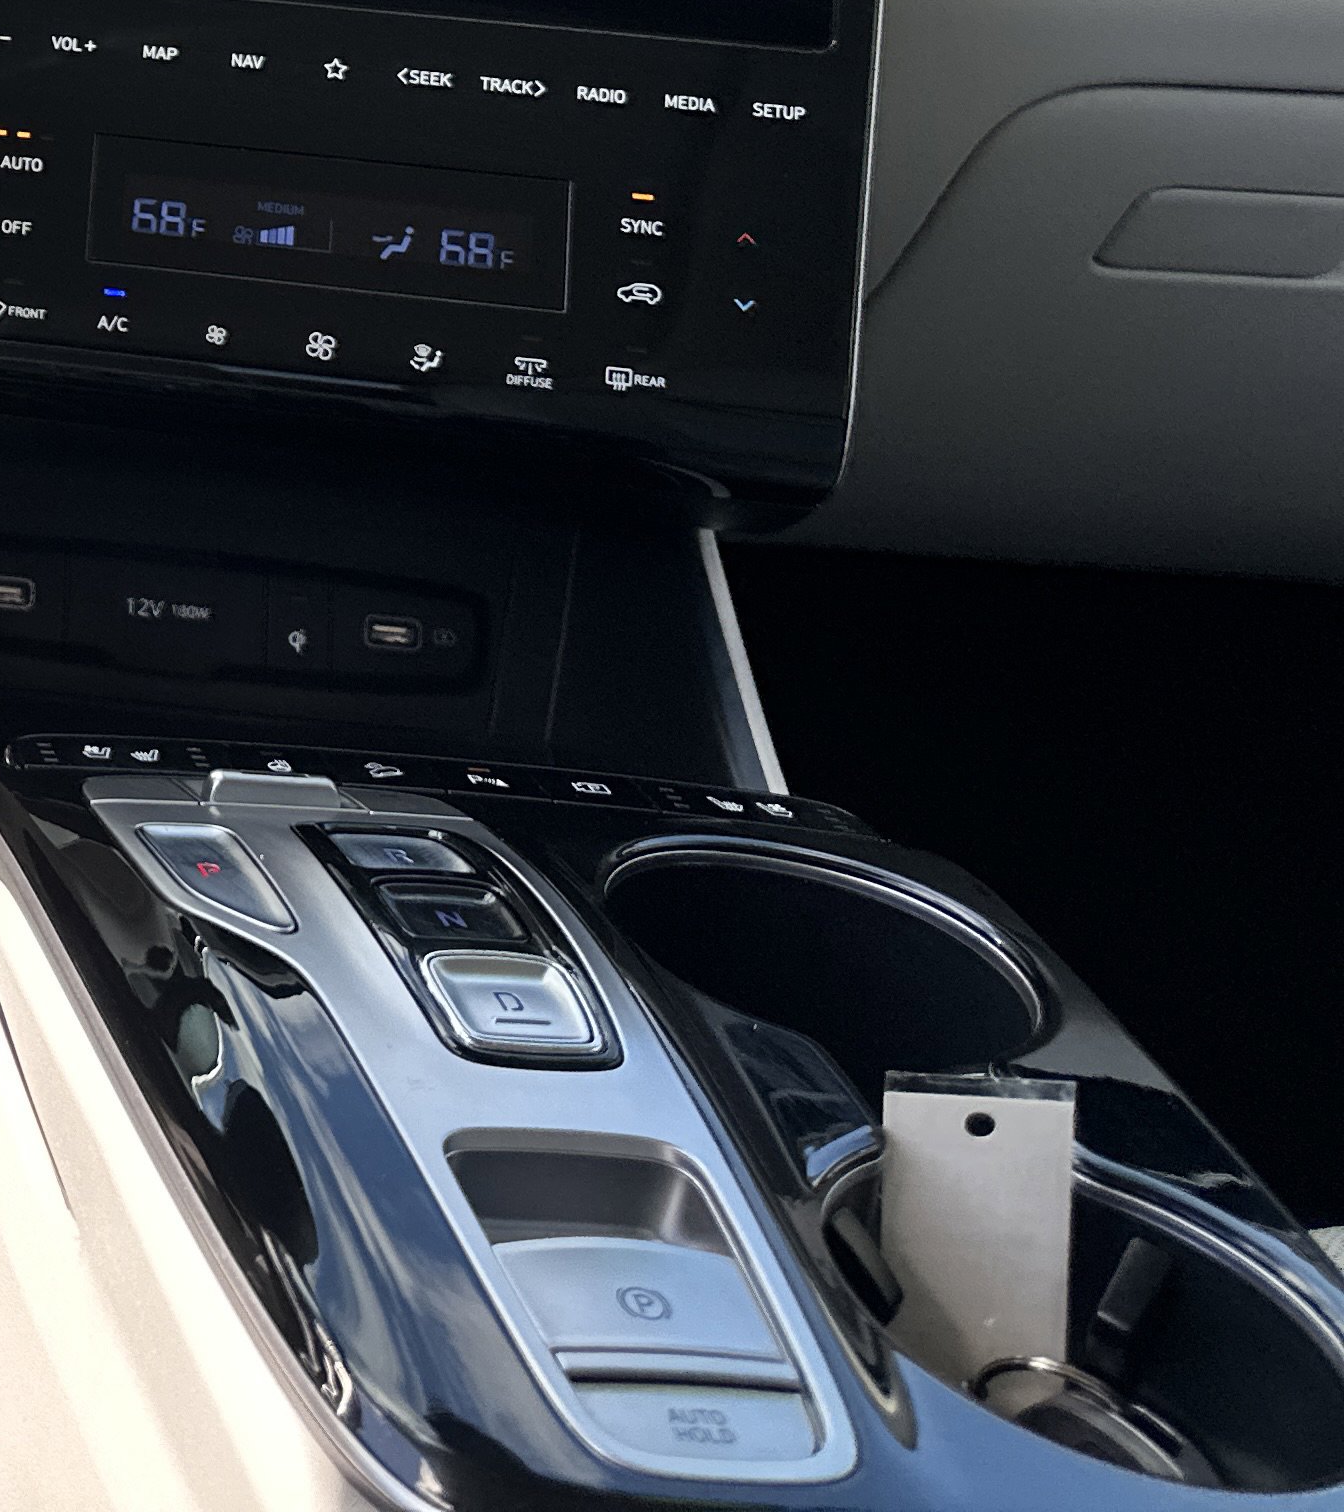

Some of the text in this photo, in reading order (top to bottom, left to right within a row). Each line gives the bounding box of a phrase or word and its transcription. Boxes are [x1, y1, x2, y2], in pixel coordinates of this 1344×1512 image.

[142, 44, 179, 61] MAP
[231, 53, 265, 70] NAV
[577, 85, 627, 104] RADIO
[664, 93, 715, 112] MEDIA
[752, 101, 806, 120] SETUP
[0, 155, 43, 173] AUTO
[257, 201, 304, 216] MEDIUM
[2, 219, 32, 235] OFF
[620, 217, 664, 237] SYNC
[8, 306, 46, 320] FRONT
[98, 315, 128, 333] A/C
[506, 373, 553, 390] DIFFUSE
[634, 374, 665, 388] REAR
[126, 597, 165, 618] 12V
[387, 848, 414, 864] R
[435, 910, 466, 929] N
[492, 991, 524, 1011] D
[667, 1408, 727, 1426] AUTO
[672, 1427, 737, 1444] HOLD
